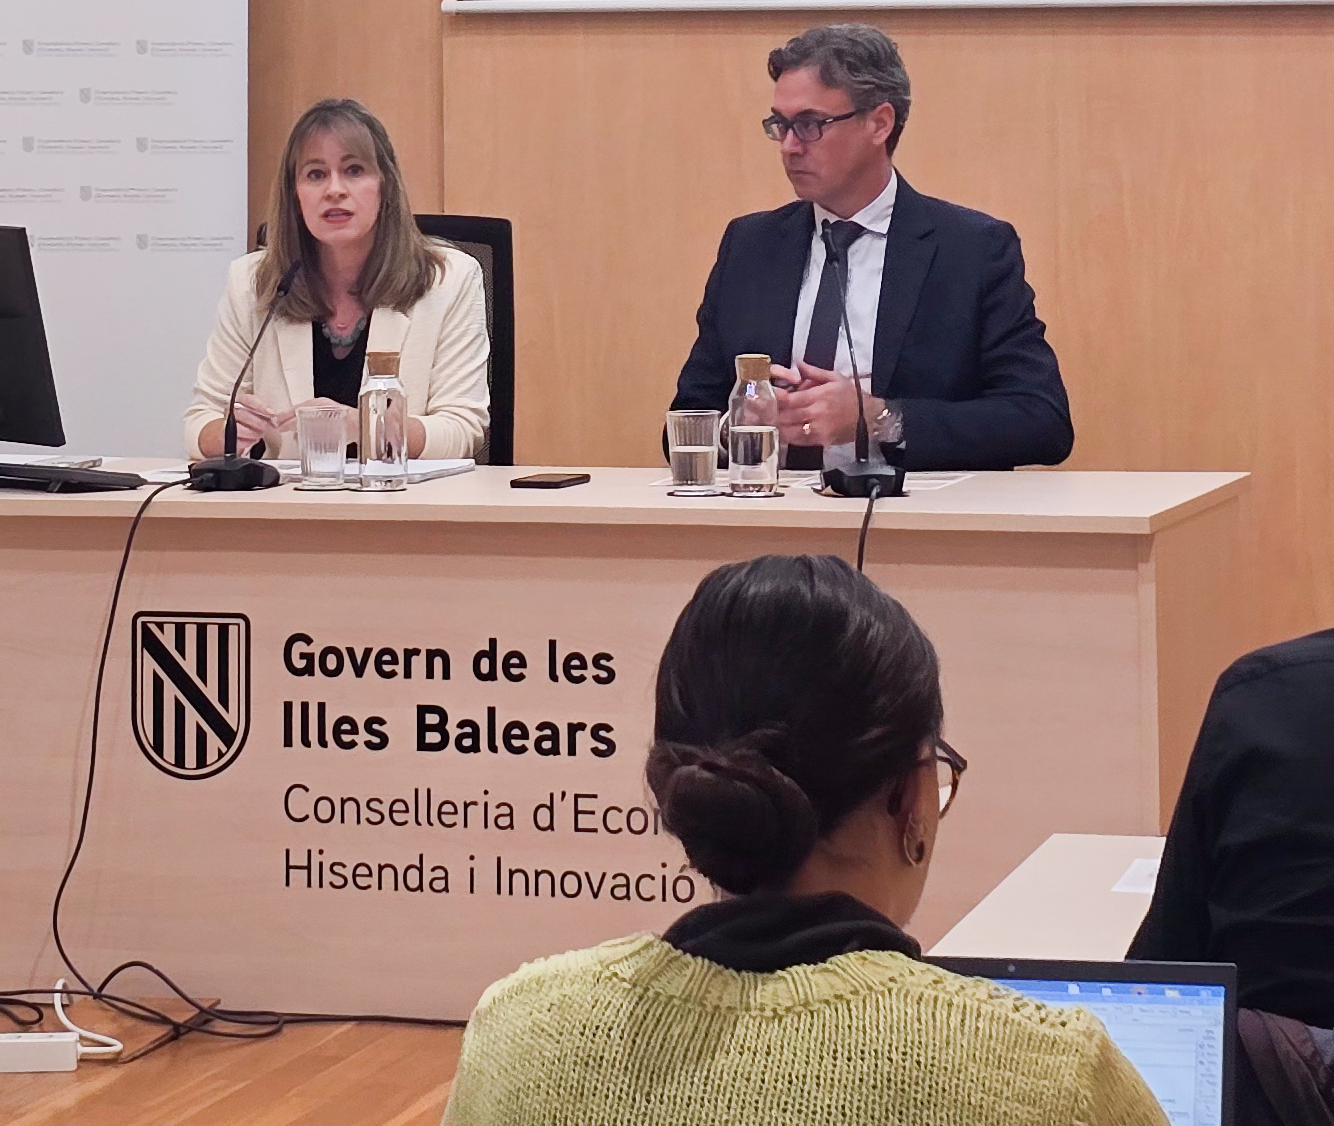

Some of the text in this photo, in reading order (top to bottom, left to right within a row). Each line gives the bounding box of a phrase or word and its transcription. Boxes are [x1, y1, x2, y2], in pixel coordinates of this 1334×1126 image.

[282, 632, 617, 686] Govern de les
[282, 700, 617, 759] Illes Balears
[283, 783, 515, 831] Conselleria
[284, 847, 695, 904] Hisenda i Innovació
